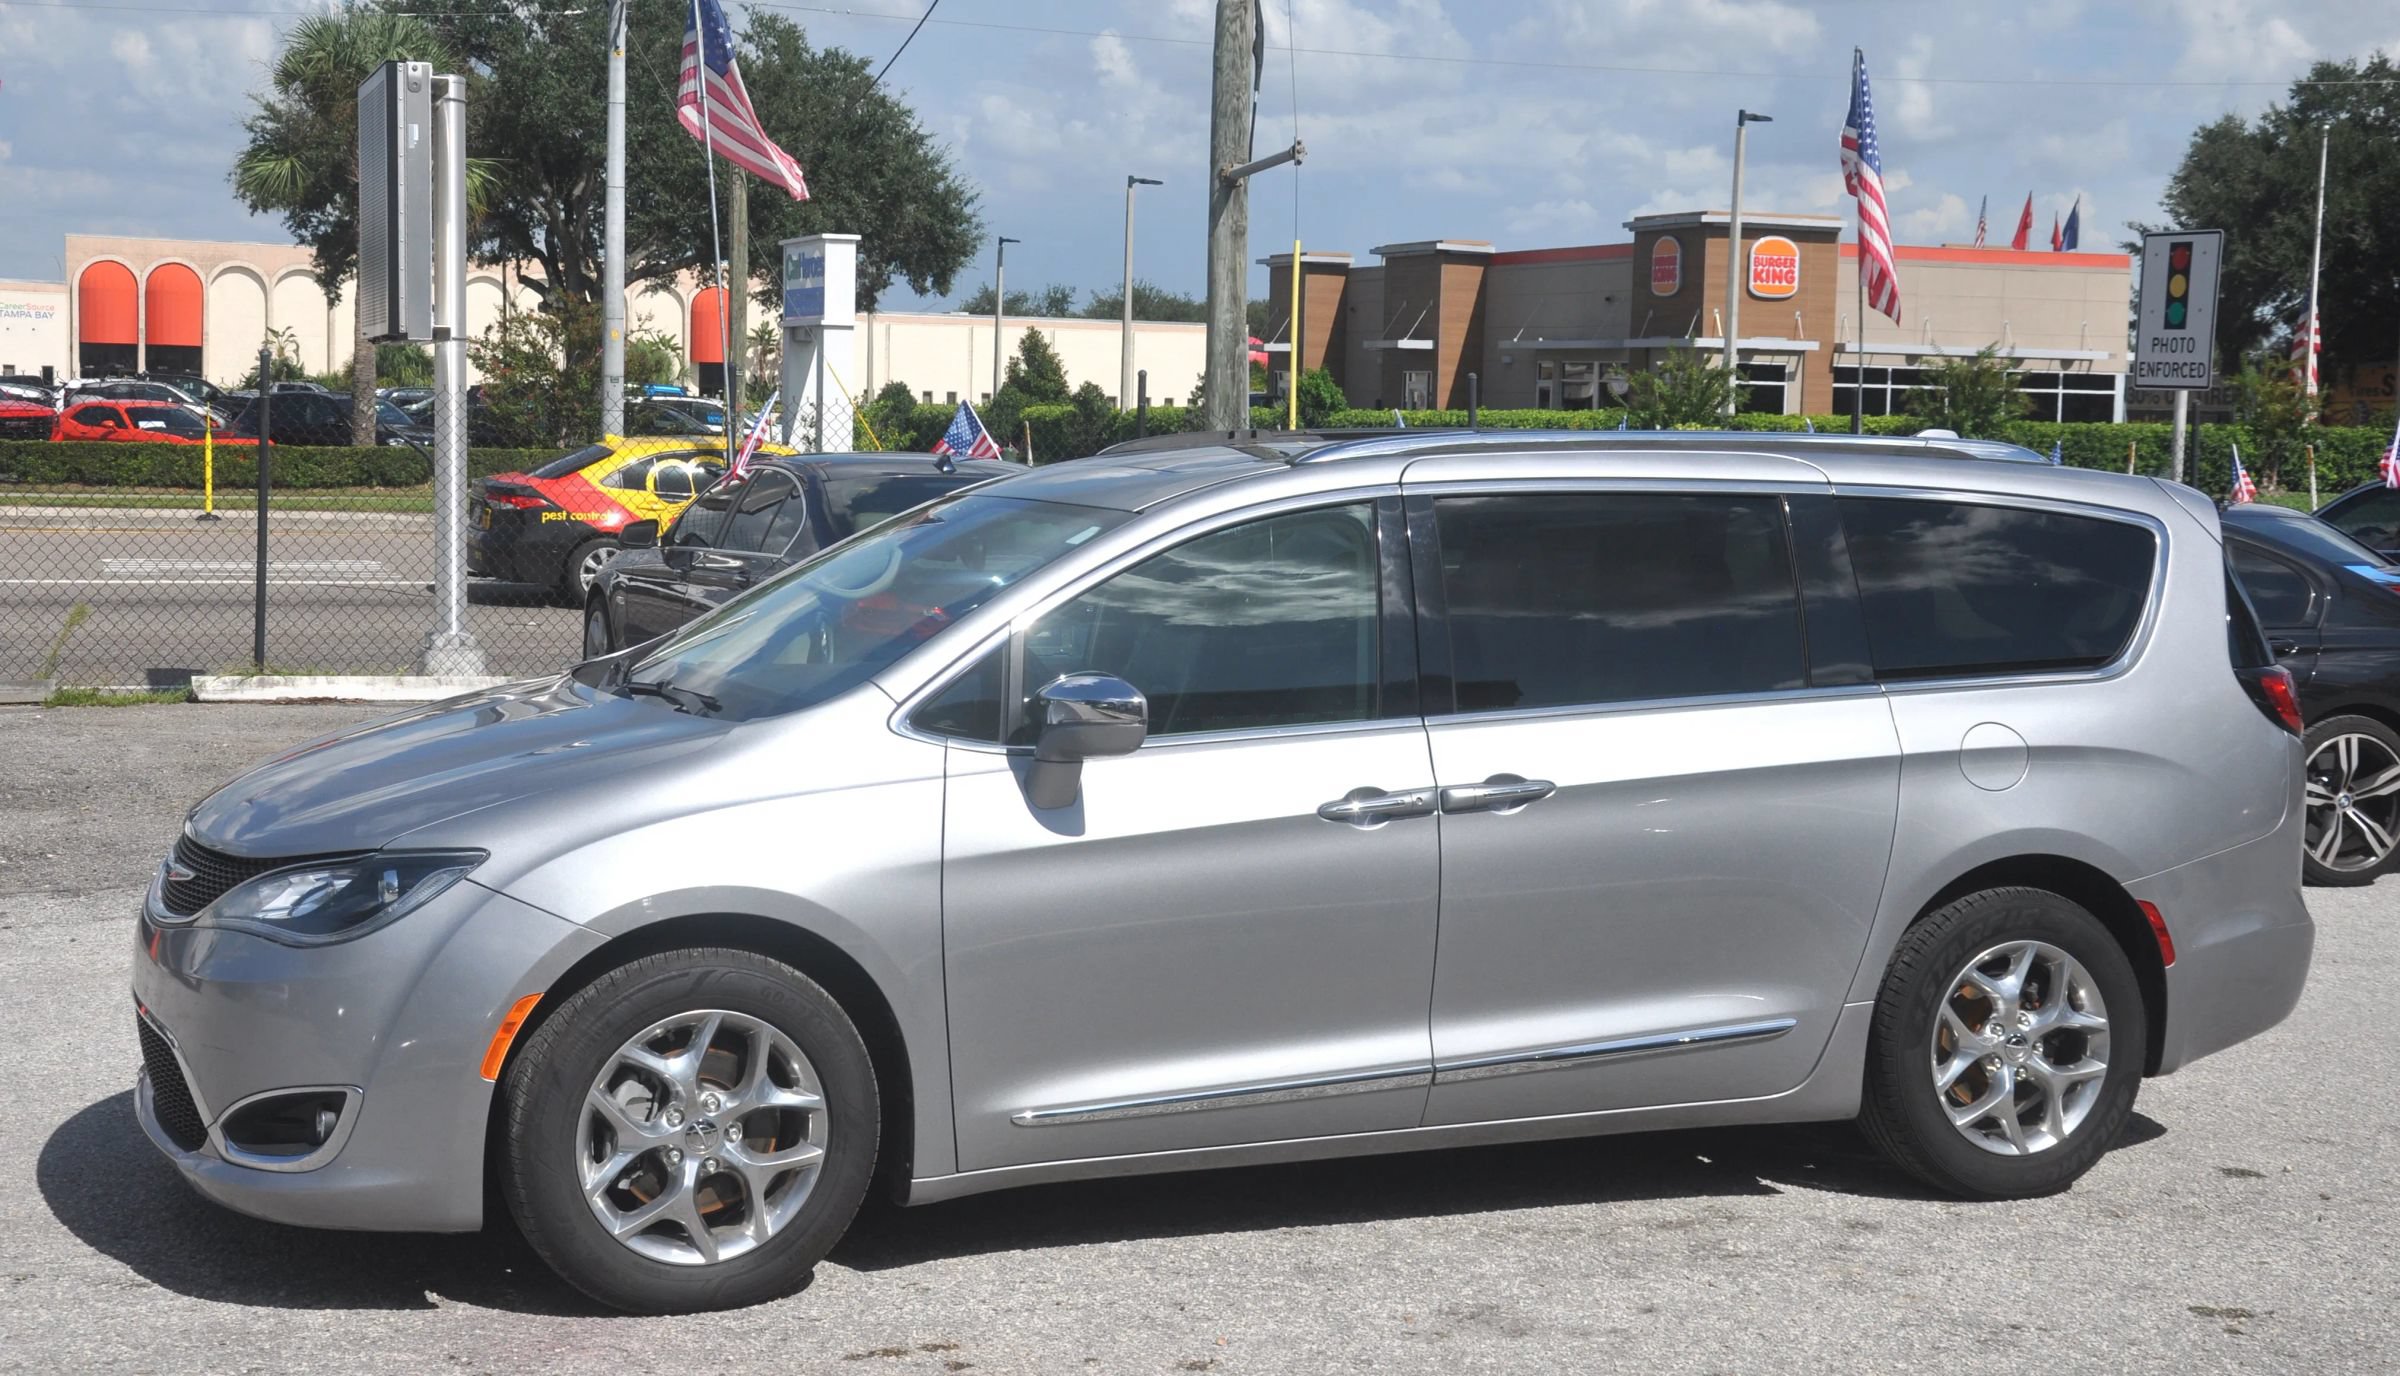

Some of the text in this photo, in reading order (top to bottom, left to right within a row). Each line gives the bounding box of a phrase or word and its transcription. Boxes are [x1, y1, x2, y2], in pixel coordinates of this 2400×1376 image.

[1753, 256, 1796, 268] BURGER
[1753, 268, 1796, 285] KING
[34, 311, 55, 319] BAY
[2151, 337, 2196, 353] PHOTO
[2138, 361, 2206, 378] ENFORCED
[541, 510, 611, 523] pest control
